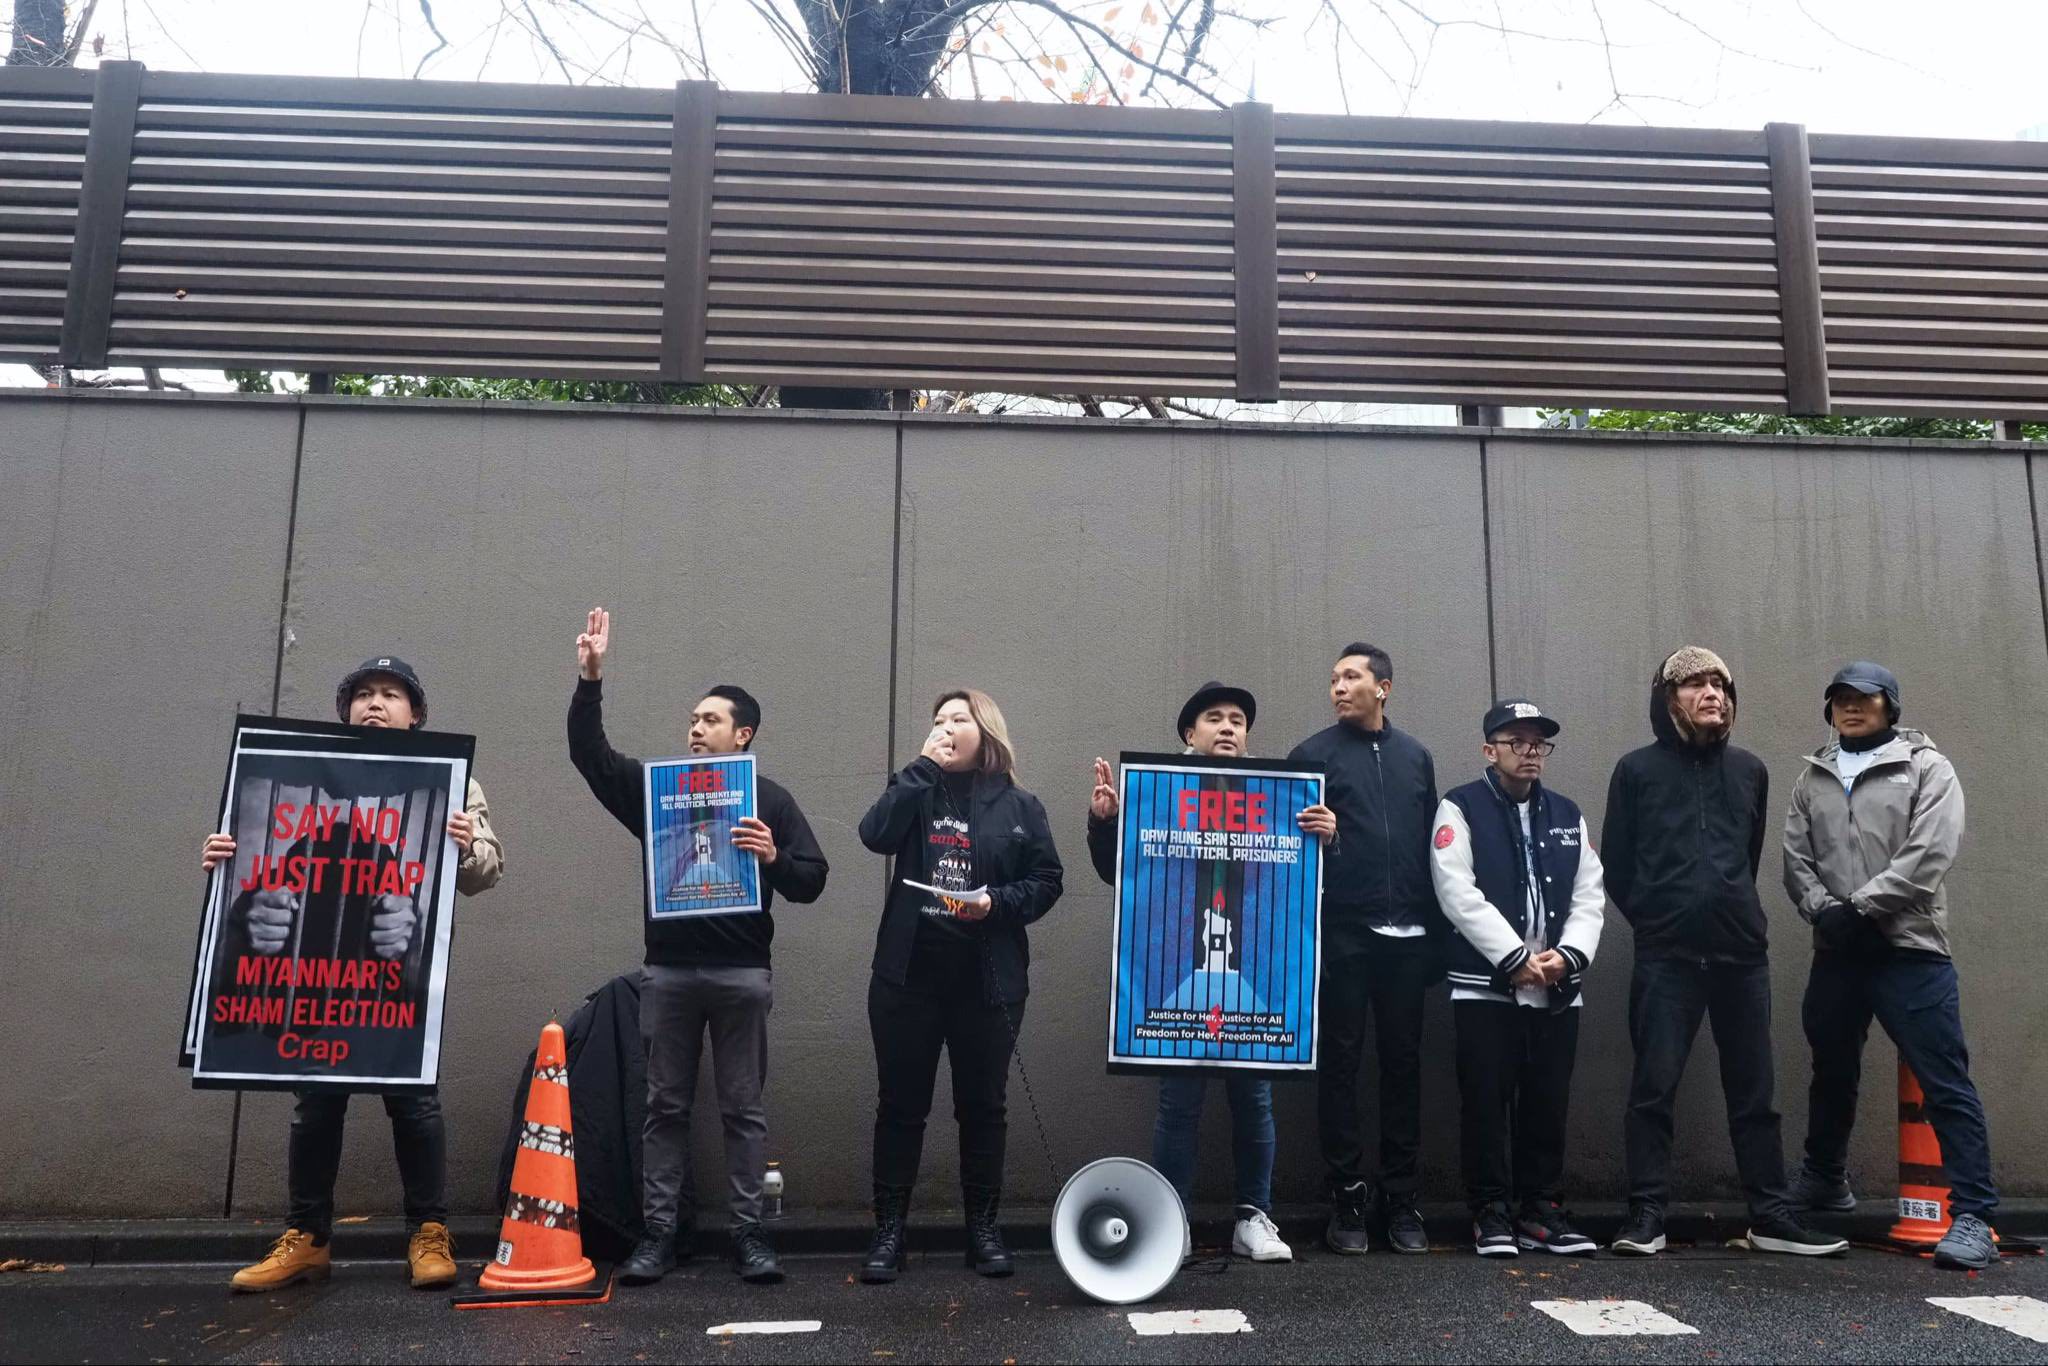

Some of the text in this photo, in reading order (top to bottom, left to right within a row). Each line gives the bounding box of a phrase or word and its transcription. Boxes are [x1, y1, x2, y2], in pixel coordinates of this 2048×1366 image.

[678, 770, 726, 794] FREE
[692, 793, 705, 801] SAN
[1178, 789, 1268, 832] FREE
[273, 802, 407, 851] SAY NO,
[1141, 829, 1302, 849] DAW AUNG SAN SUU KYI AND
[1143, 844, 1298, 863] ALL POLITICAL PRISONERS
[240, 854, 425, 897] JUST TRAP
[236, 956, 401, 990] MYANMAR'S
[214, 995, 415, 1028] SHAM ELECTION
[1148, 1011, 1282, 1024] Justice for Her, Justice for All
[278, 1032, 349, 1066] Crap
[1136, 1028, 1293, 1043] Freedom for Her, Freedom for All
